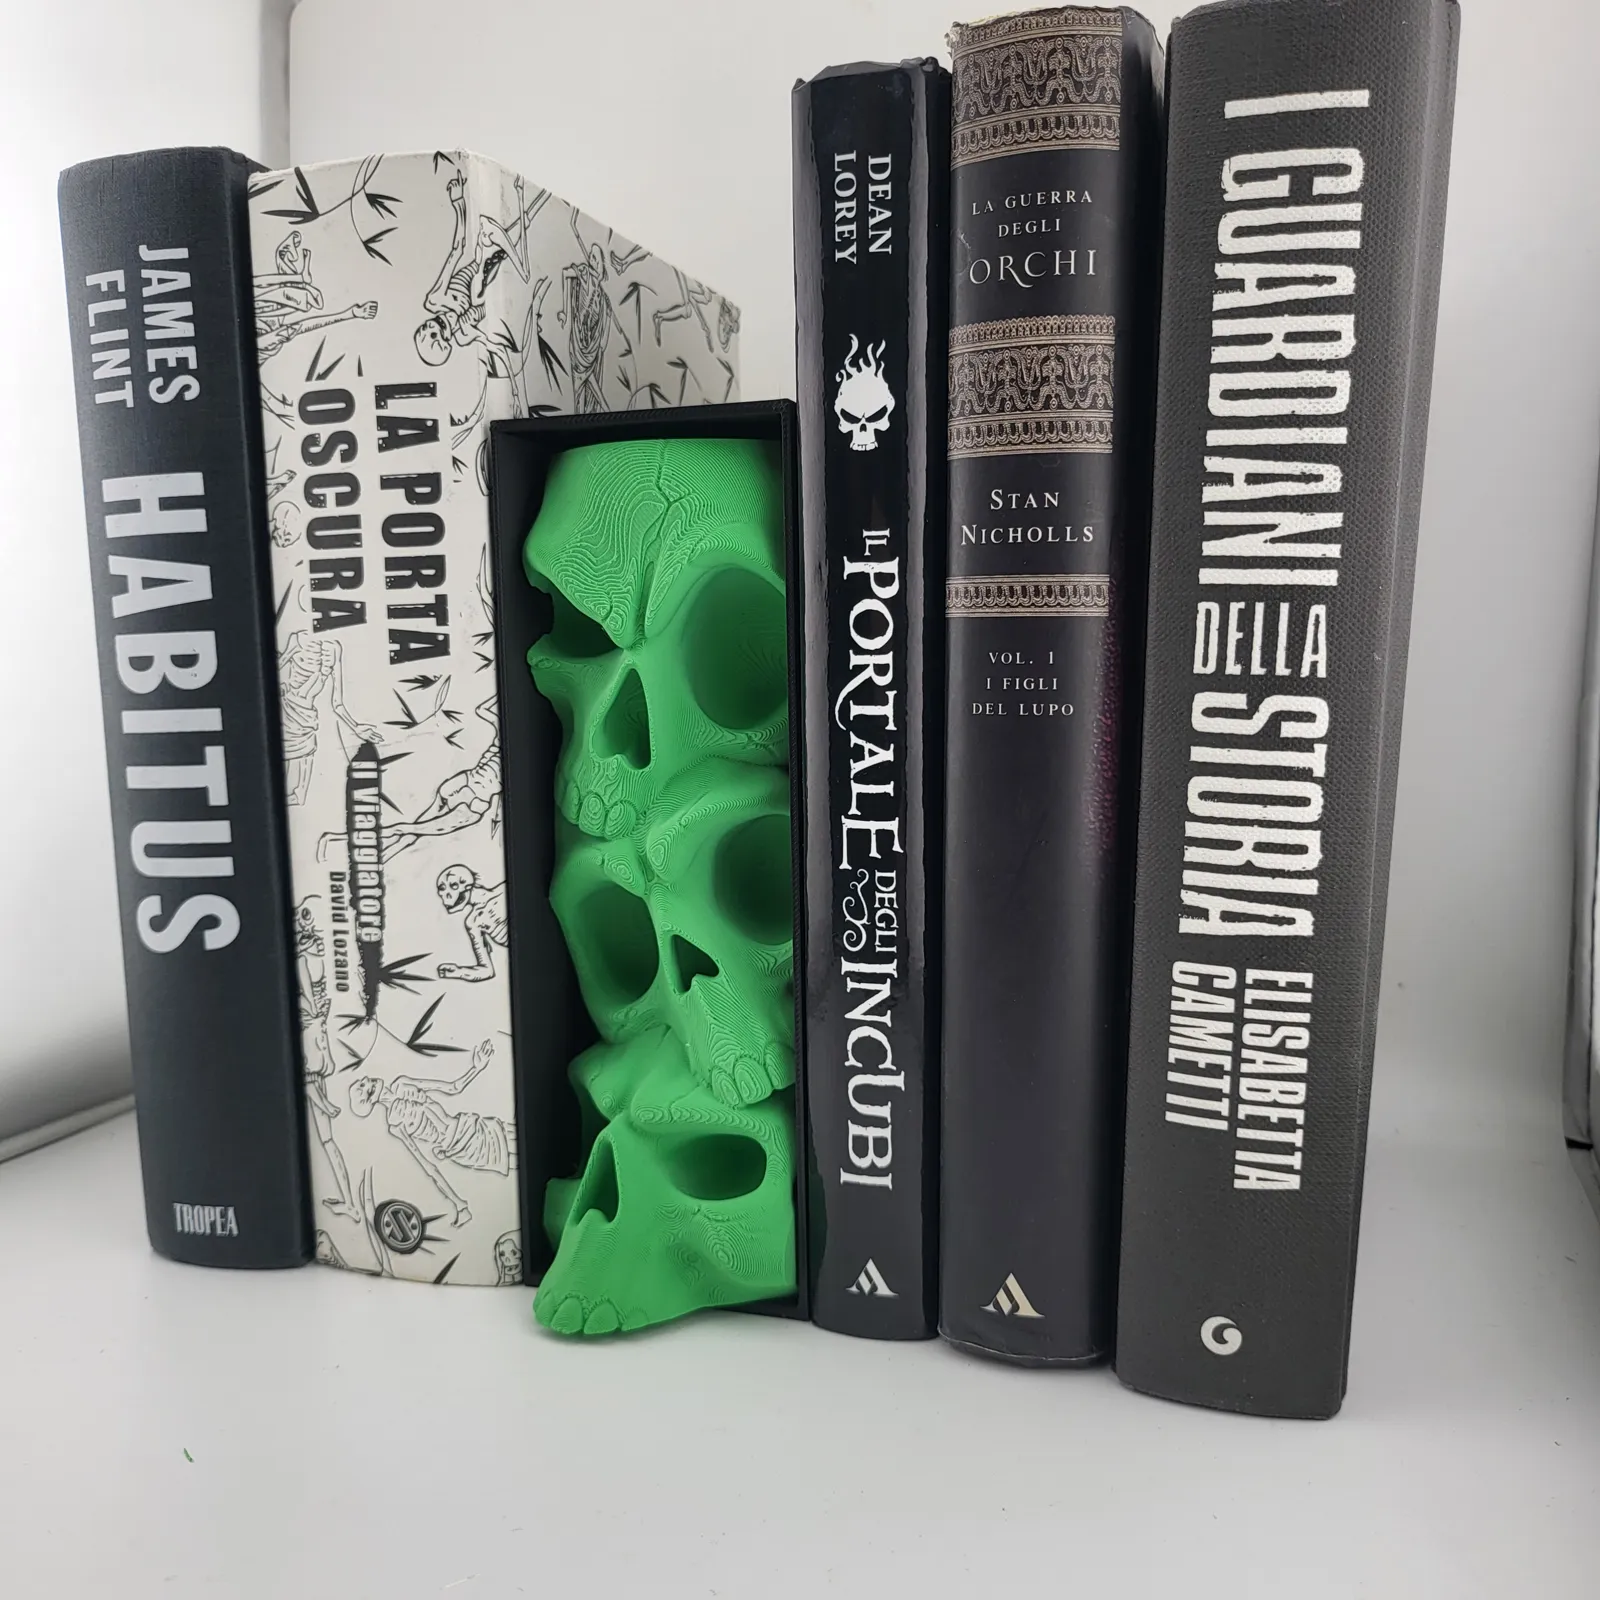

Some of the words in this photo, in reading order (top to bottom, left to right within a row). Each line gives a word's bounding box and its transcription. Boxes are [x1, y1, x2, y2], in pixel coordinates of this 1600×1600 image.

[1223, 89, 1370, 119] I
[834, 150, 857, 264] LOREY
[868, 153, 892, 255] DEAN
[971, 200, 995, 216] LA
[1004, 189, 1093, 210] GUERRA
[998, 218, 1062, 238] DEGLI
[969, 249, 1097, 288] ORCHI
[85, 269, 134, 409] FLINT
[138, 244, 201, 404] JAMES
[1199, 147, 1365, 586] GUARDIANI
[373, 381, 440, 454] LA
[297, 387, 367, 634] OSCURA
[378, 471, 452, 665] PORTA
[986, 676, 992, 690] I
[1003, 676, 1059, 690] FIGLI
[988, 651, 1034, 665] VOL.
[1192, 601, 1327, 678] DELLA
[101, 471, 242, 955] HABITUS
[835, 556, 904, 871] PORTALE
[972, 702, 1008, 716] DEL
[1019, 702, 1075, 717] LUPO
[351, 759, 378, 779] Il
[1178, 691, 1331, 937] STORIA
[328, 870, 348, 924] David
[349, 785, 384, 944] Viaggiatore
[874, 869, 898, 953] DEGLI
[333, 930, 350, 993] Lozano
[839, 955, 906, 1191] INCUBI
[1165, 960, 1237, 1131] CAMETTI
[1233, 969, 1314, 1191] ELISABETTA
[172, 1202, 239, 1238] TROPEA
